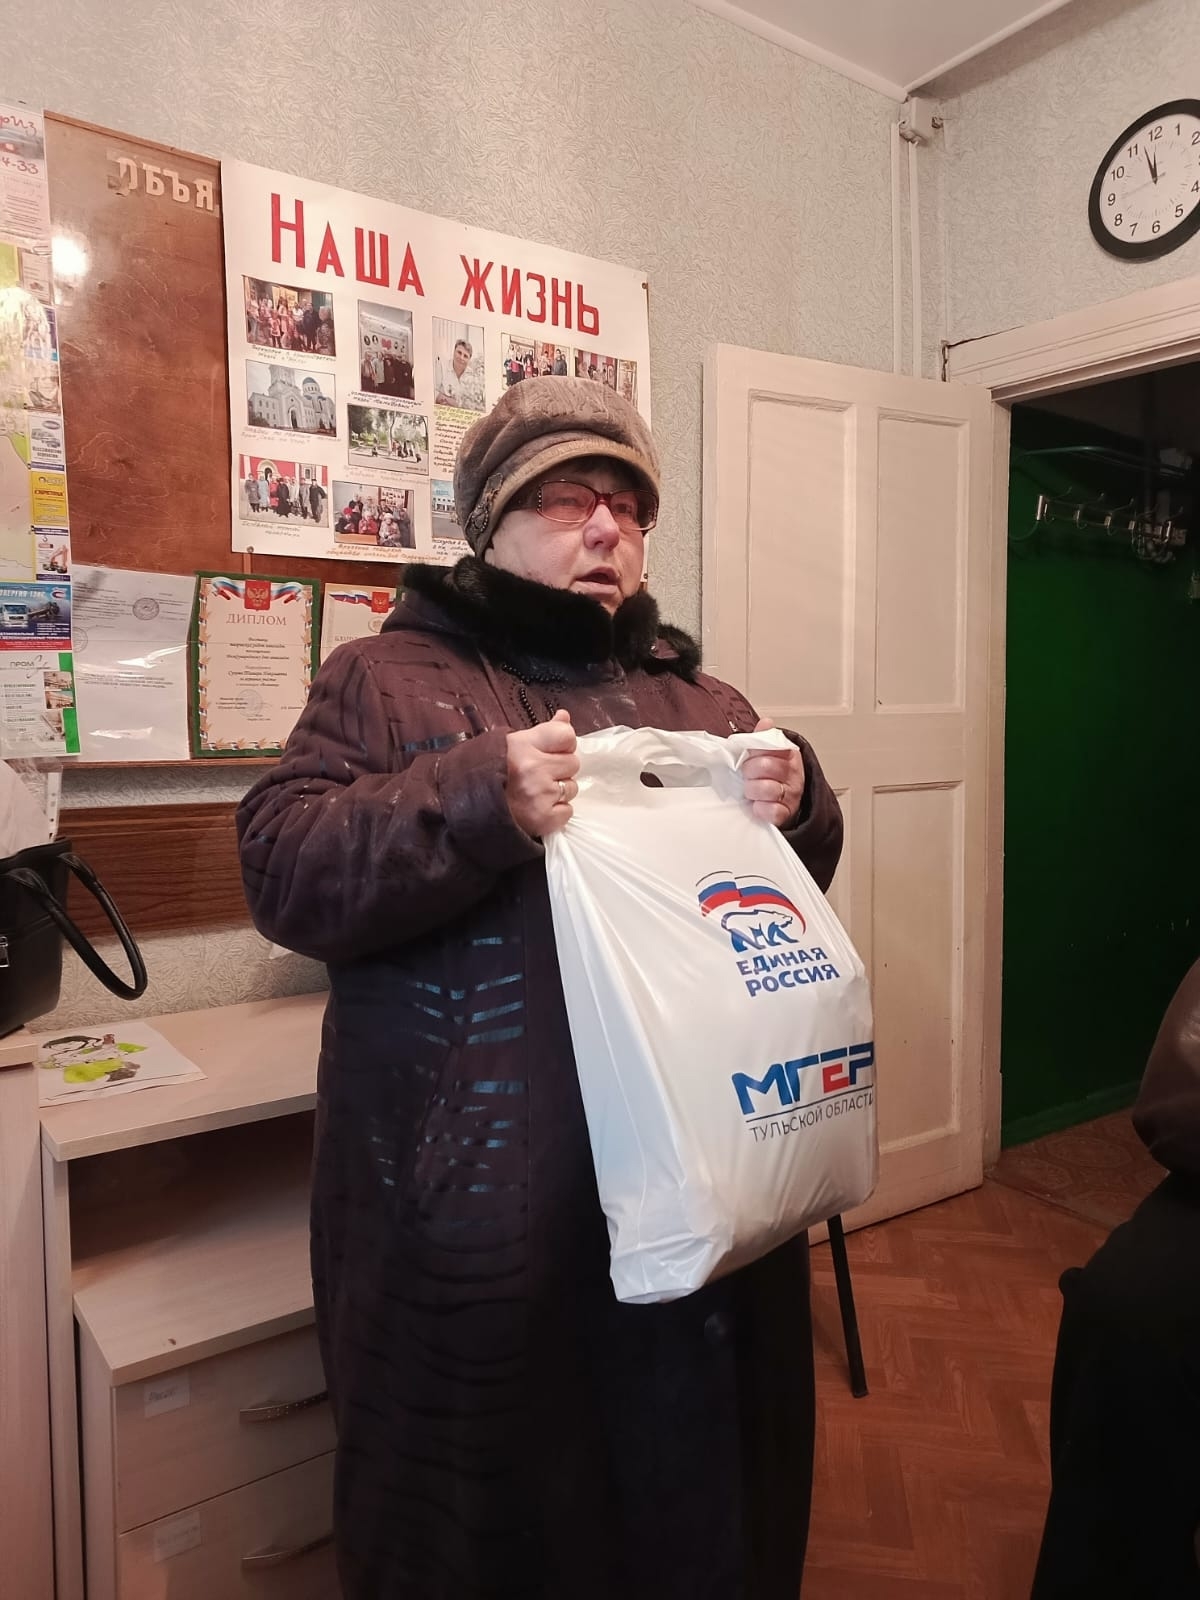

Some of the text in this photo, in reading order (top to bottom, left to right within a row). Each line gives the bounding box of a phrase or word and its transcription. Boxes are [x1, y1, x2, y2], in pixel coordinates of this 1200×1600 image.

[1148, 126, 1163, 142] 12
[1174, 123, 1181, 136] 1
[1191, 131, 1200, 146] 2
[1127, 144, 1138, 158] 11
[1111, 166, 1125, 182] 10
[1191, 180, 1200, 193] 4
[1107, 193, 1116, 206] 9
[1174, 204, 1184, 218] 5
[1114, 213, 1123, 227] 8
[1129, 223, 1138, 237] 7
[1151, 221, 1161, 234] 6
[270, 192, 600, 336] НАША ЖИЗНЬ
[225, 613, 287, 626] ДИПЛОМ
[735, 946, 828, 976] ЕДИНАЯ
[745, 963, 840, 998] РОССИЯ
[731, 1041, 874, 1115] МГЕР
[750, 1106, 823, 1143] ТУЛЬСКОЙ
